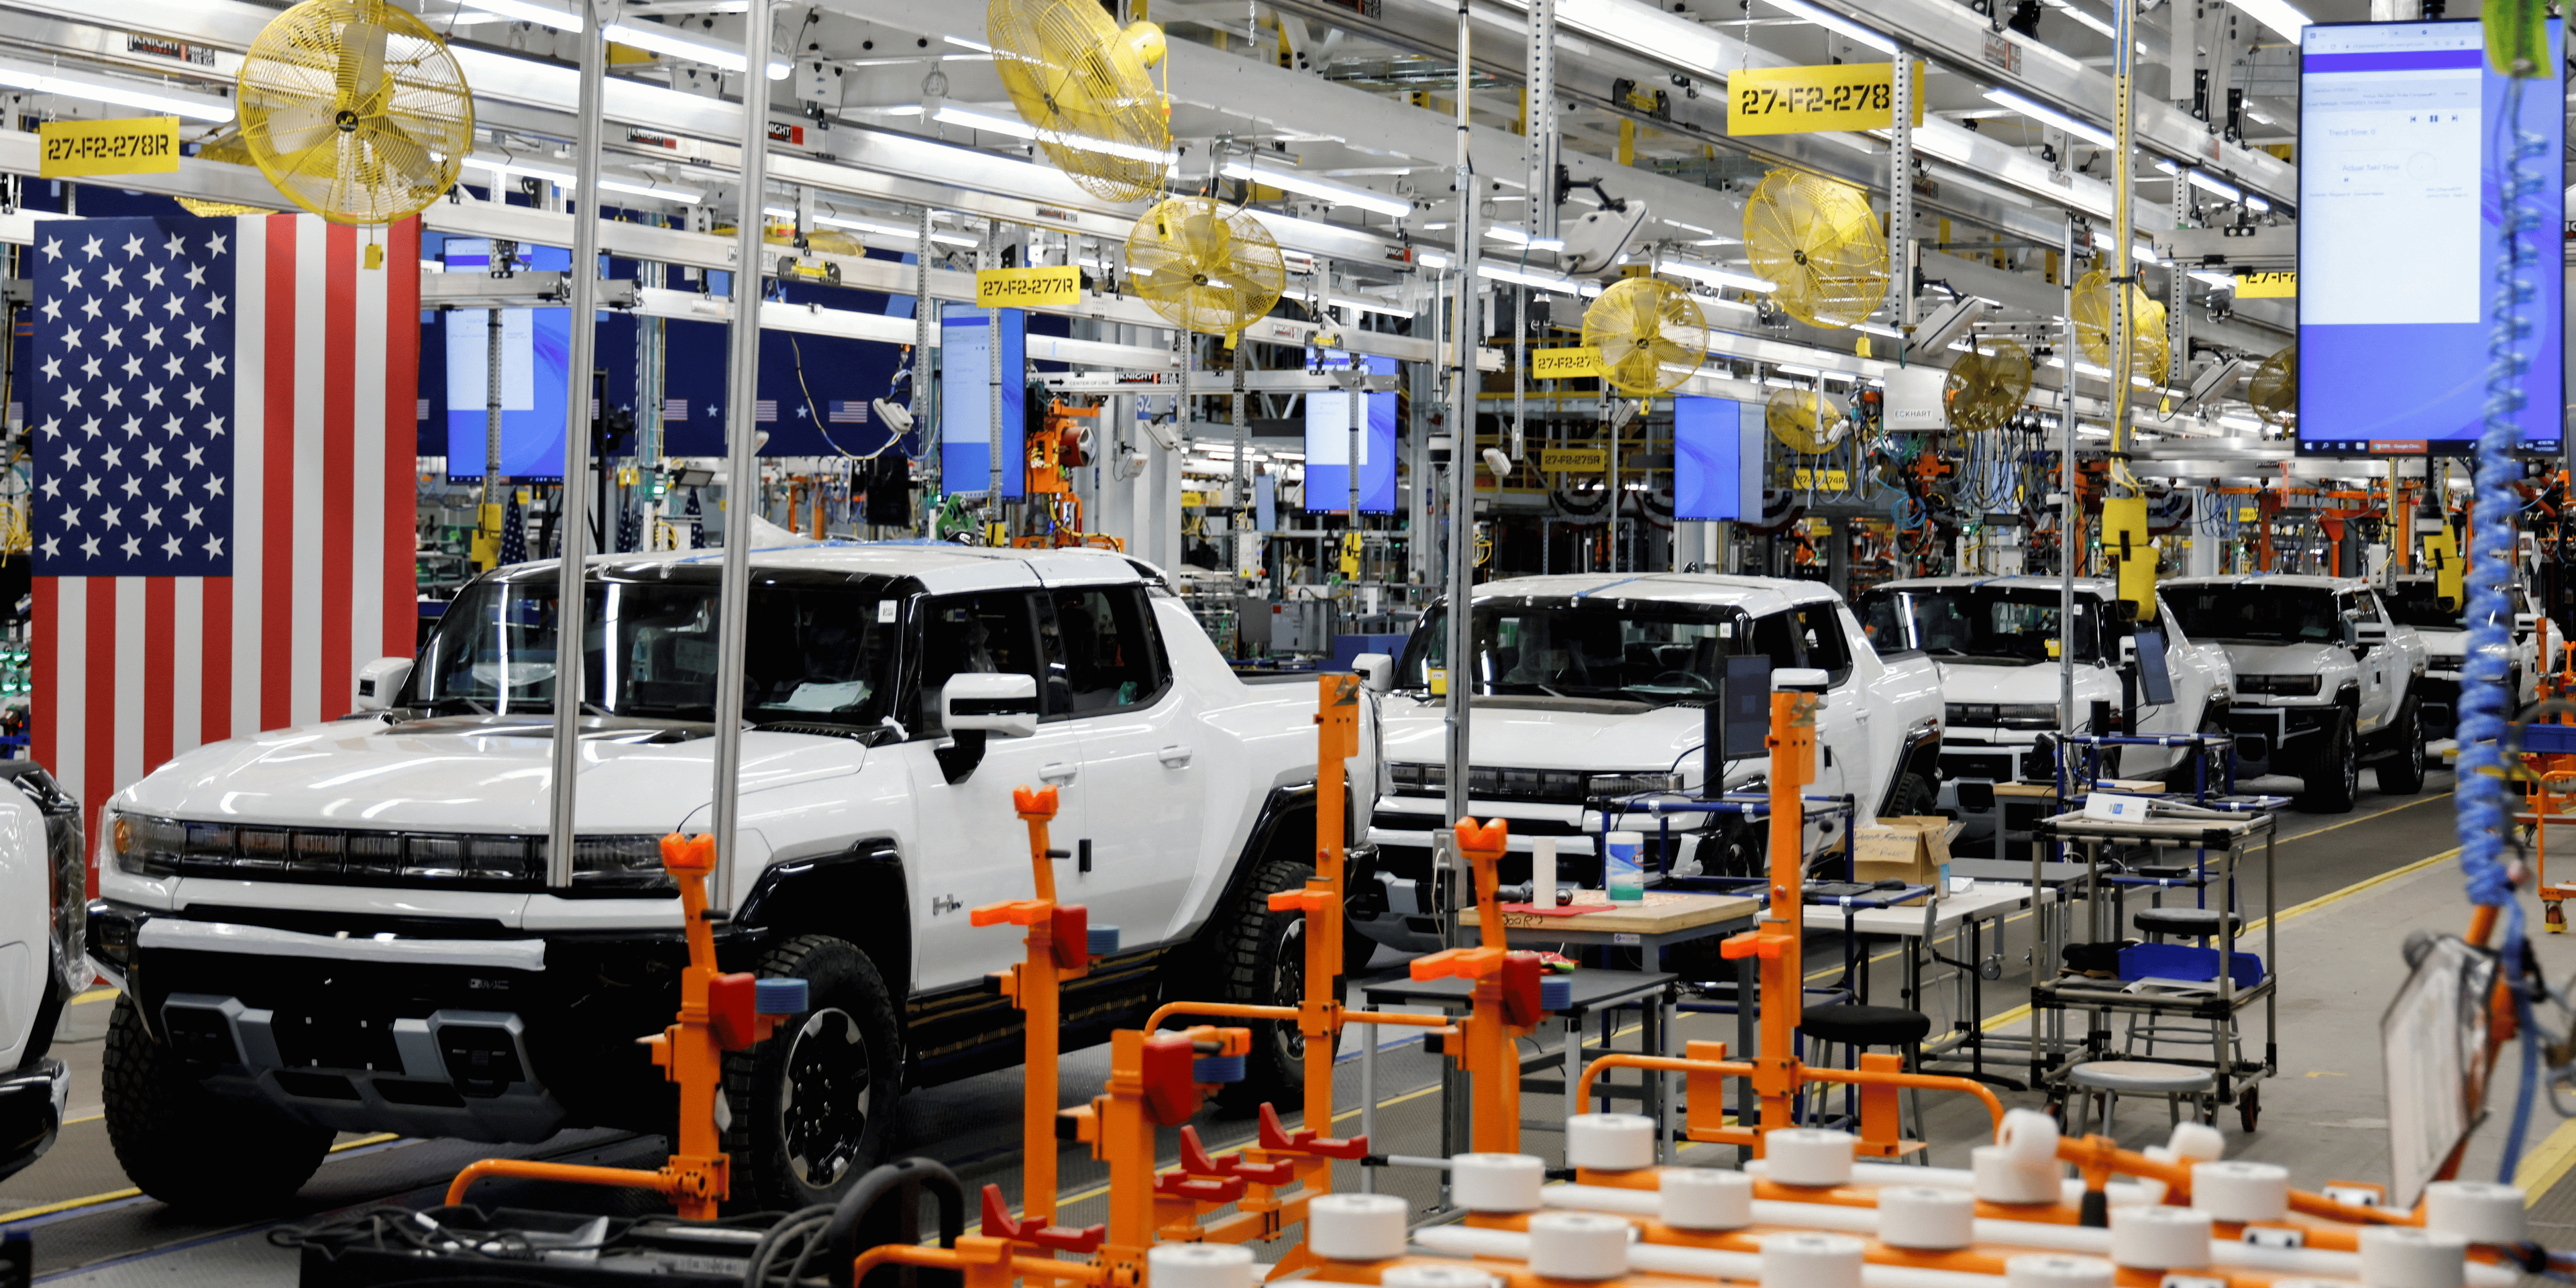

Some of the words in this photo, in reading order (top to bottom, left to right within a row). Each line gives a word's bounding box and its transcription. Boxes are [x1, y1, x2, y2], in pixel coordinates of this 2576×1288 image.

[1742, 84, 1890, 115] 27-F2-278
[631, 127, 663, 142] KNIGHT
[768, 122, 790, 136] NIGHT
[48, 134, 168, 160] 27-F2-278R
[1387, 246, 1404, 257] KNIGHT
[983, 278, 1073, 296] 27-F2-277R
